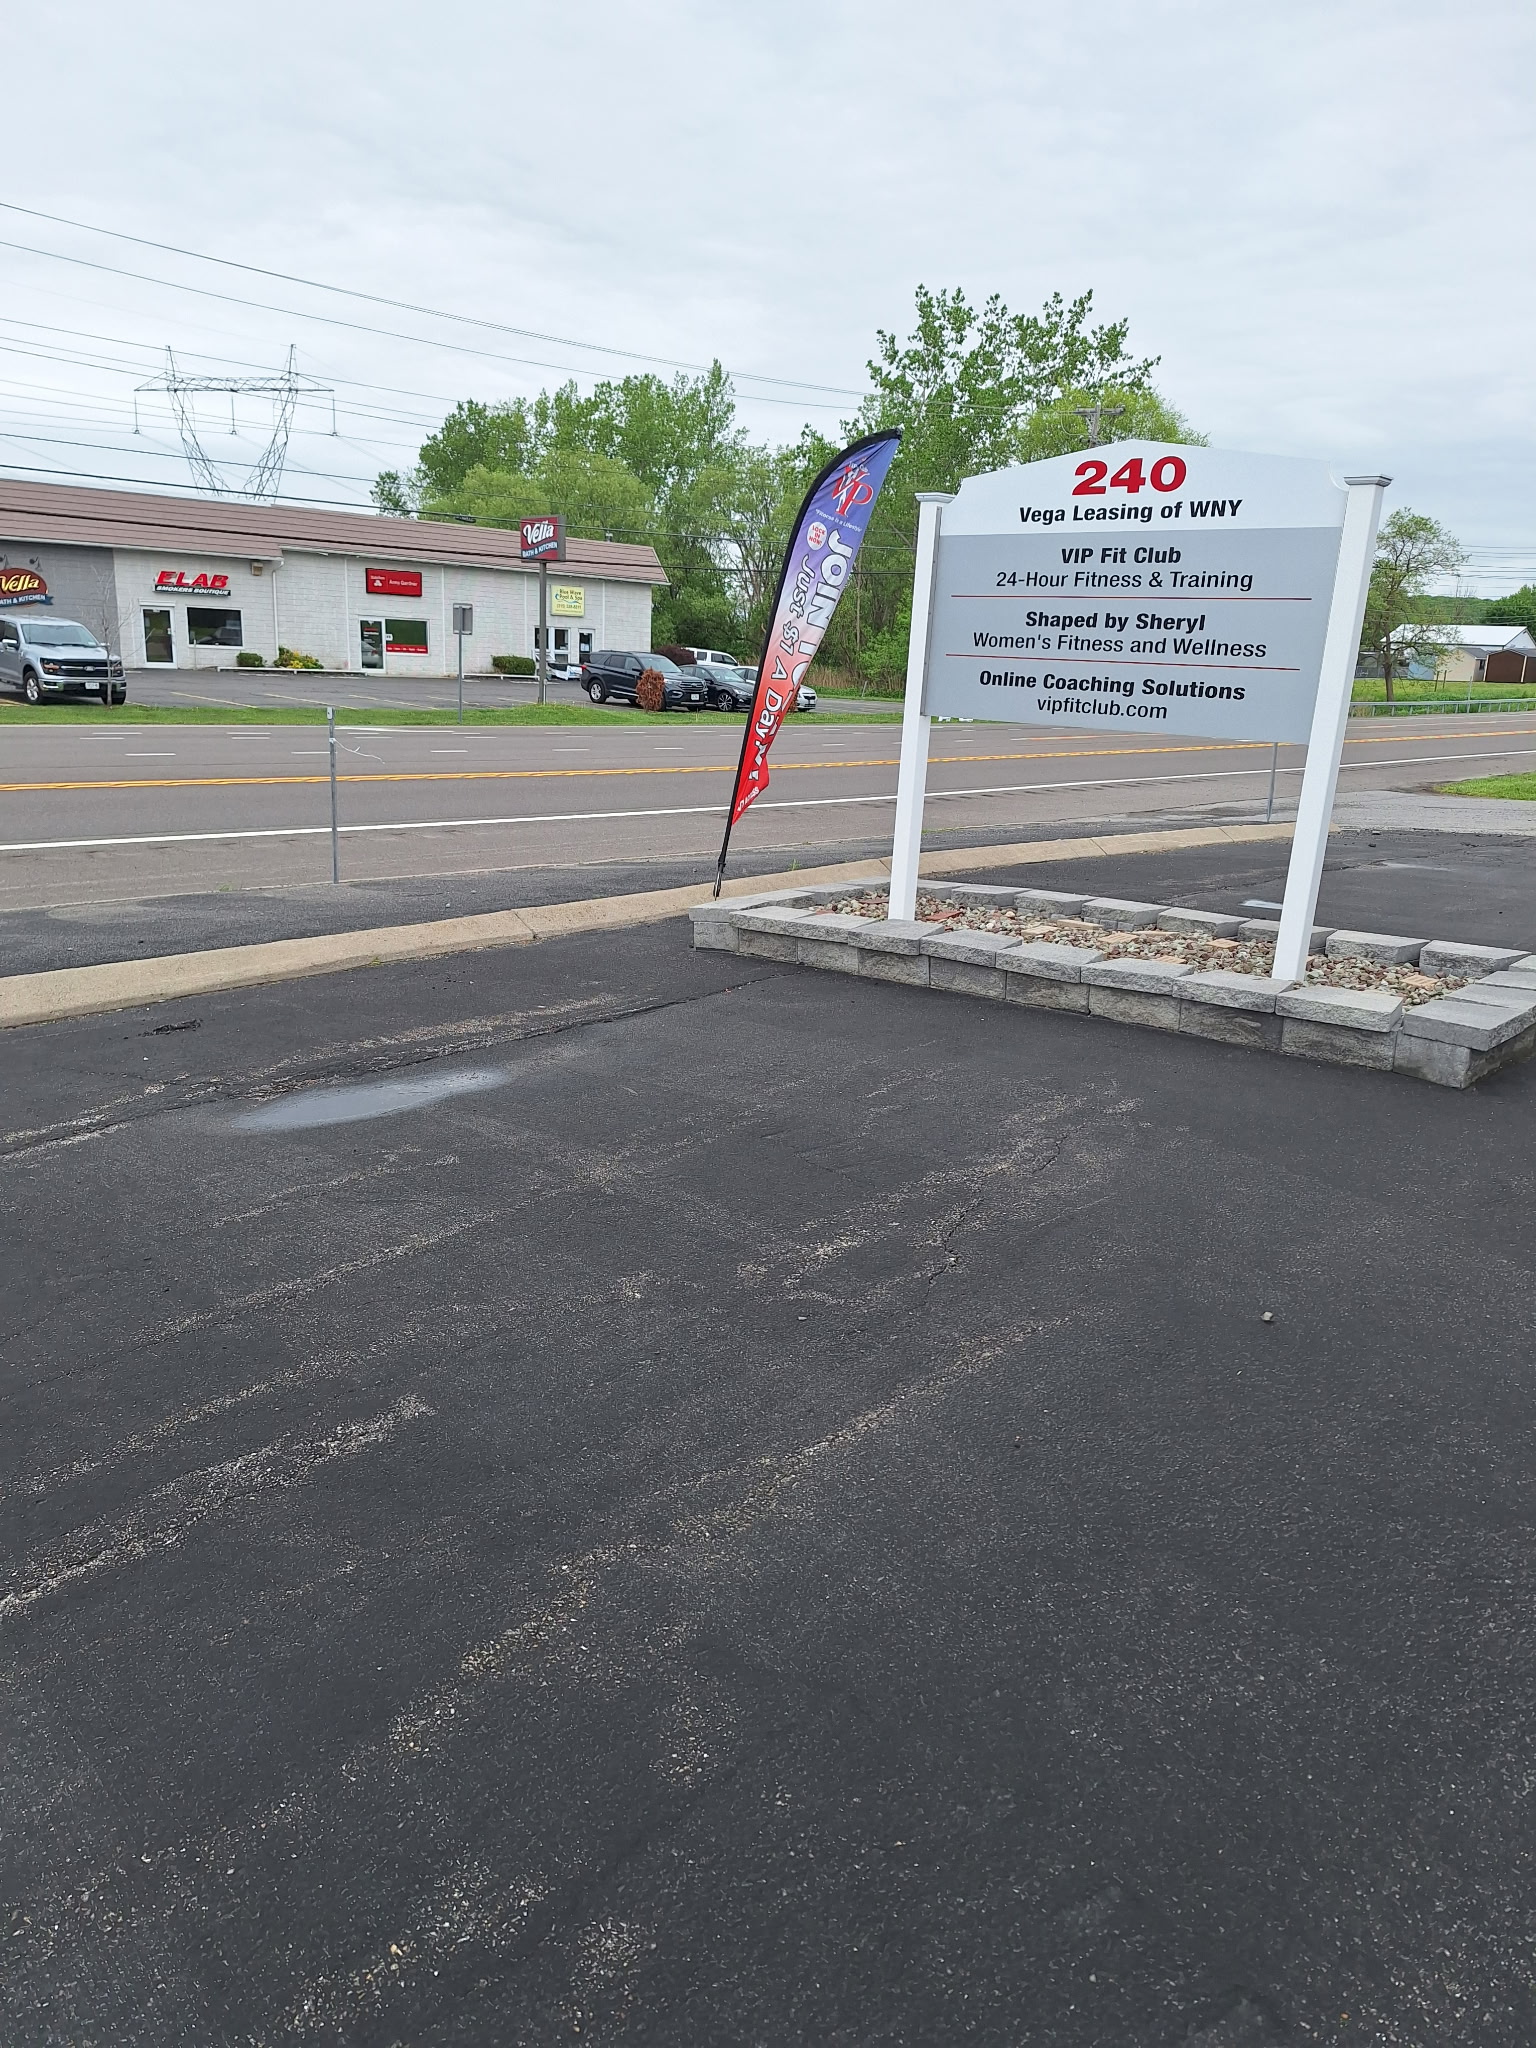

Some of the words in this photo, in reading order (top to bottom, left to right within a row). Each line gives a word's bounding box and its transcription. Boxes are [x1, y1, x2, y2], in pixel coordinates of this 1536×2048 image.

[1072, 455, 1187, 495] 240
[1019, 507, 1066, 525] Vega
[1073, 503, 1153, 522] Leasing
[1160, 501, 1183, 519] of
[1190, 499, 1243, 518] WNY
[522, 519, 555, 545] Vella
[538, 541, 558, 553] KITCHEN
[1061, 548, 1094, 564] VIP
[1100, 547, 1127, 564] Fit
[1133, 546, 1182, 564] Club
[0, 574, 40, 592] Vella
[156, 585, 193, 593] SMOKERS
[157, 570, 229, 589] ELAB
[789, 553, 816, 620] Just
[806, 528, 854, 631] JOIN
[996, 571, 1068, 587] 24-Hour
[1074, 571, 1142, 588] Fitness
[1150, 571, 1163, 588] &
[1170, 570, 1253, 591] Training
[19, 594, 46, 603] KITCHEN
[1025, 611, 1098, 630] Shaped
[1104, 612, 1129, 632] by
[1135, 612, 1206, 633] Sheryl
[779, 620, 800, 657] $1
[973, 632, 1051, 650] Women's
[1057, 635, 1123, 652] Fitness
[1130, 638, 1166, 654] and
[1173, 638, 1267, 657] Wellness
[771, 656, 788, 680] A
[979, 670, 1037, 688] Online
[1043, 674, 1134, 697] Coaching
[1141, 678, 1246, 700] Solutions
[755, 686, 783, 739] Day
[1037, 696, 1167, 718] vipfitclub.com
